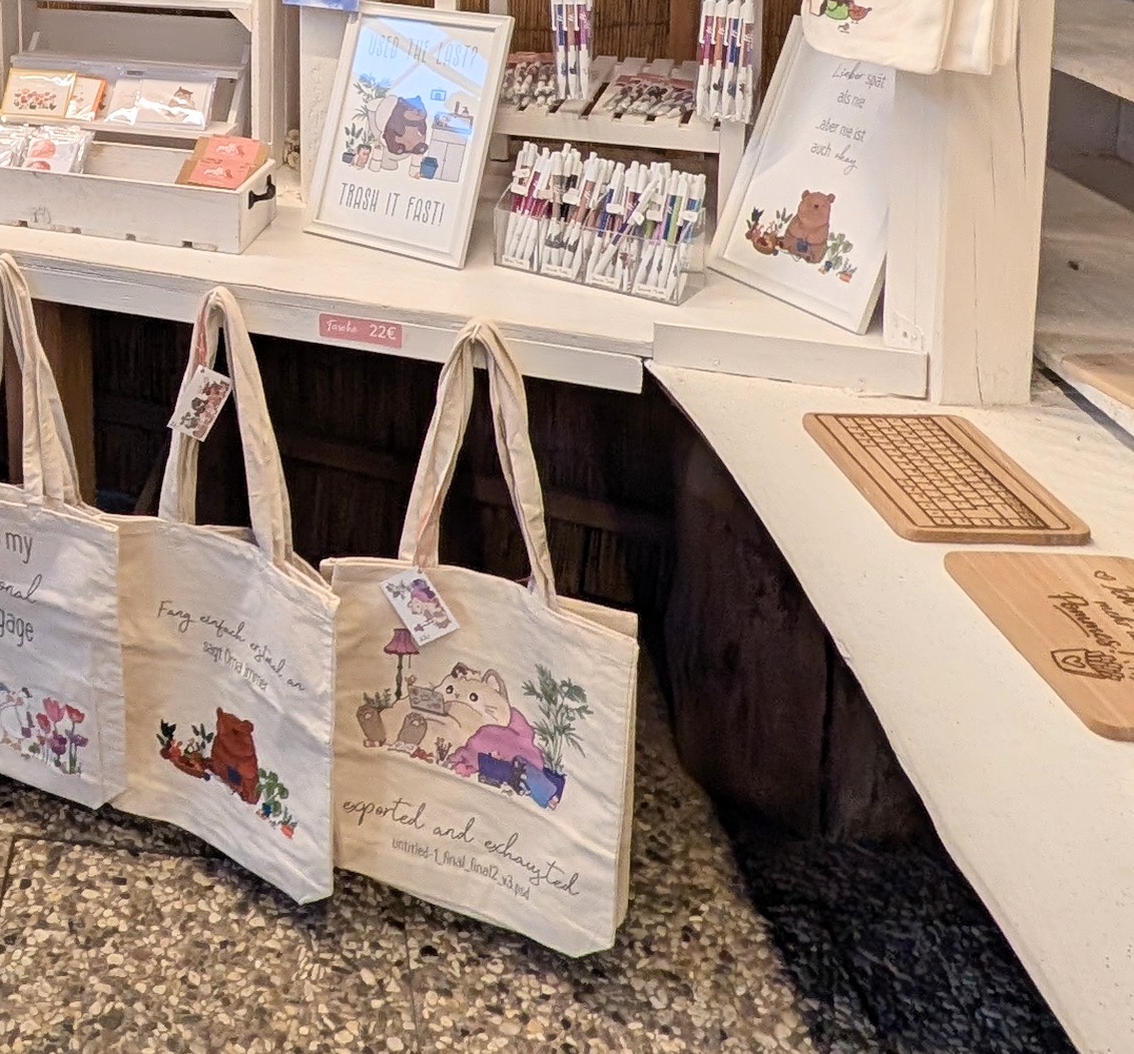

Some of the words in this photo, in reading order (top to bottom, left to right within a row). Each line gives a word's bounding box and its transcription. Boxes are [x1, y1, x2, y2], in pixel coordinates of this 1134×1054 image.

[369, 33, 399, 59] USED
[407, 38, 430, 63] THE
[435, 41, 478, 68] LAST?
[837, 89, 850, 105] als
[810, 142, 831, 157] auch
[339, 182, 380, 212] TRASH
[385, 192, 401, 217] IT
[405, 196, 446, 227] FAST!
[369, 324, 397, 340] 22€
[5, 531, 33, 564] my
[157, 600, 194, 633] Fang
[199, 615, 246, 643] einfach
[287, 678, 306, 692] an
[343, 797, 426, 830] exported
[433, 816, 474, 844] and
[484, 832, 581, 897] exhausted
